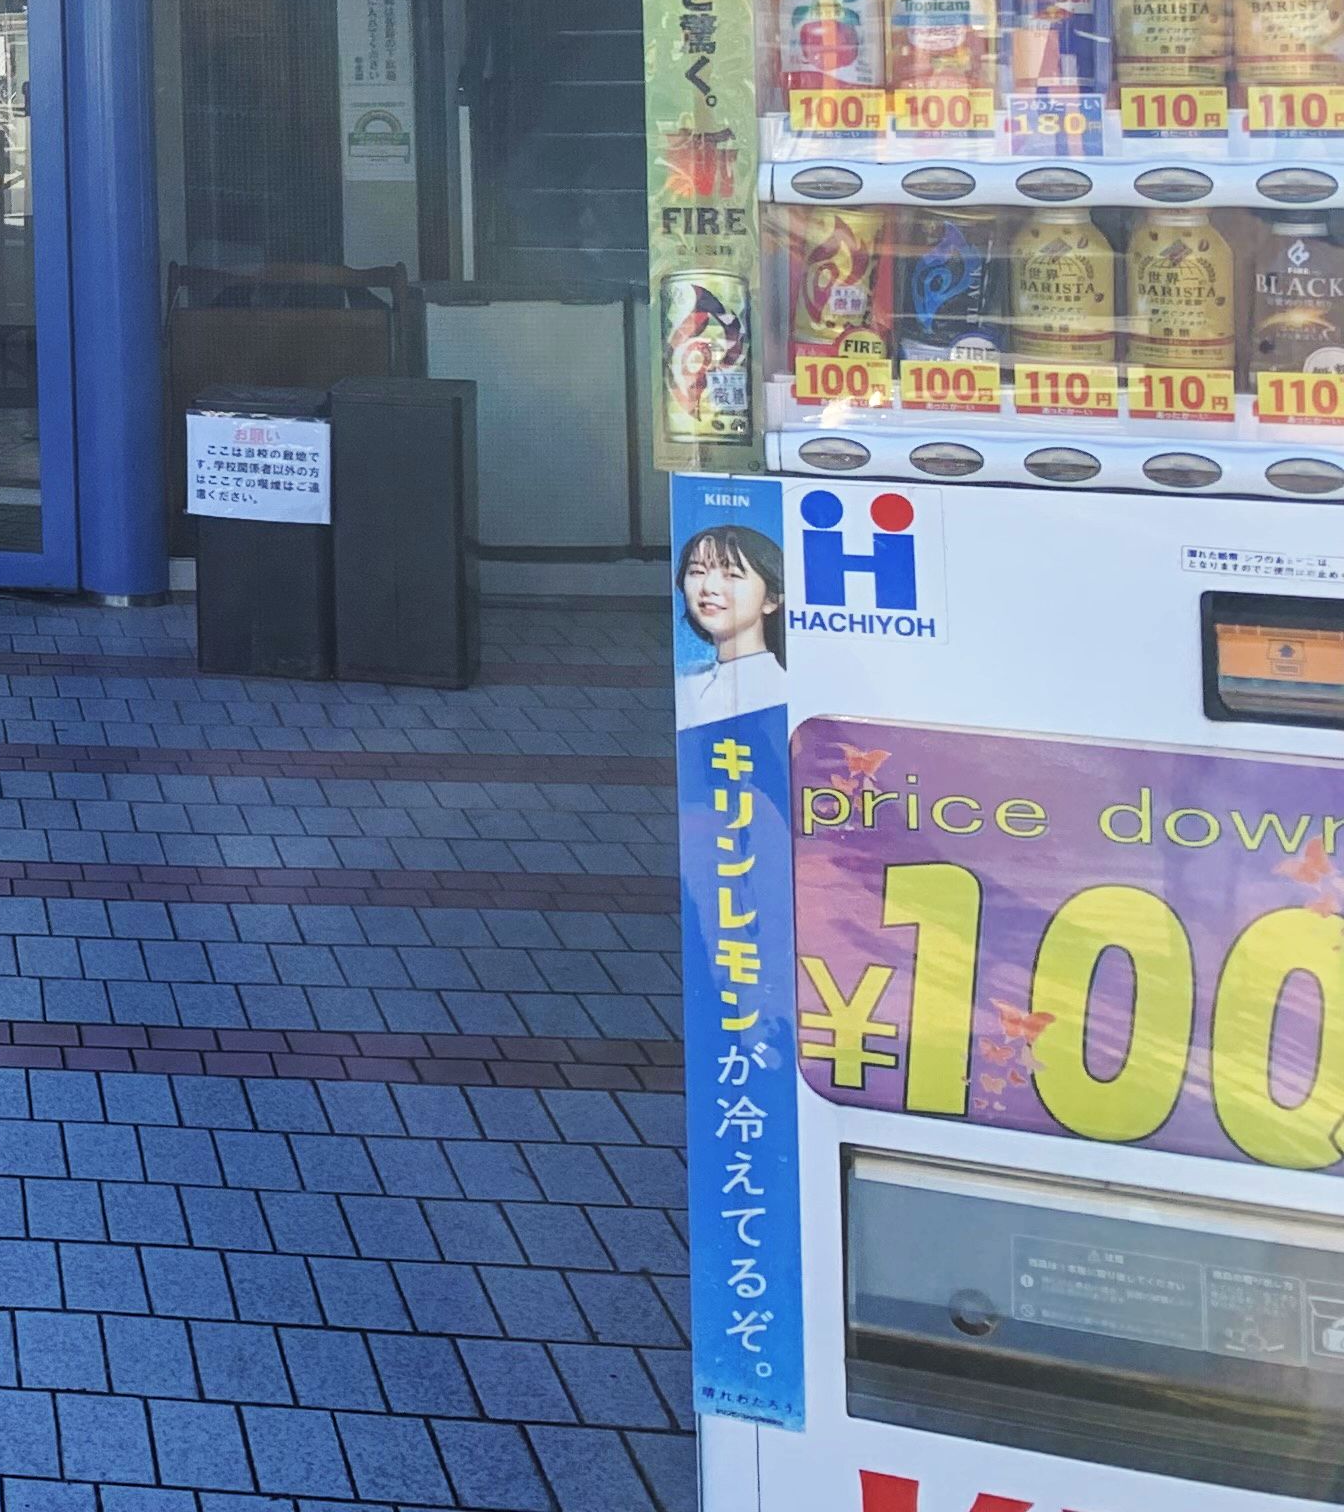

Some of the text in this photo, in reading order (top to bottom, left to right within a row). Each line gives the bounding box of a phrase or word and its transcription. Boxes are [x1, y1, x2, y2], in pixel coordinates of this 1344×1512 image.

[1132, 2, 1210, 15] BARISTA
[1251, 0, 1329, 14] BARISTA
[661, 206, 747, 237] FIRE
[1019, 279, 1095, 294] BARISTA
[1137, 283, 1216, 298] BARISTA
[1255, 273, 1344, 298] BLACK
[842, 339, 883, 355] FIRE
[1025, 371, 1113, 407] 110円
[1138, 374, 1229, 411] 110円
[1268, 378, 1339, 414] 110
[233, 427, 281, 443] お願い
[207, 445, 320, 463] ここは当校の敷地で
[704, 492, 751, 508] KIRIN
[788, 610, 937, 638] HACHIYOH
[800, 774, 1049, 839] price
[710, 738, 775, 1379] キリンレモンが冷えてるぞ。
